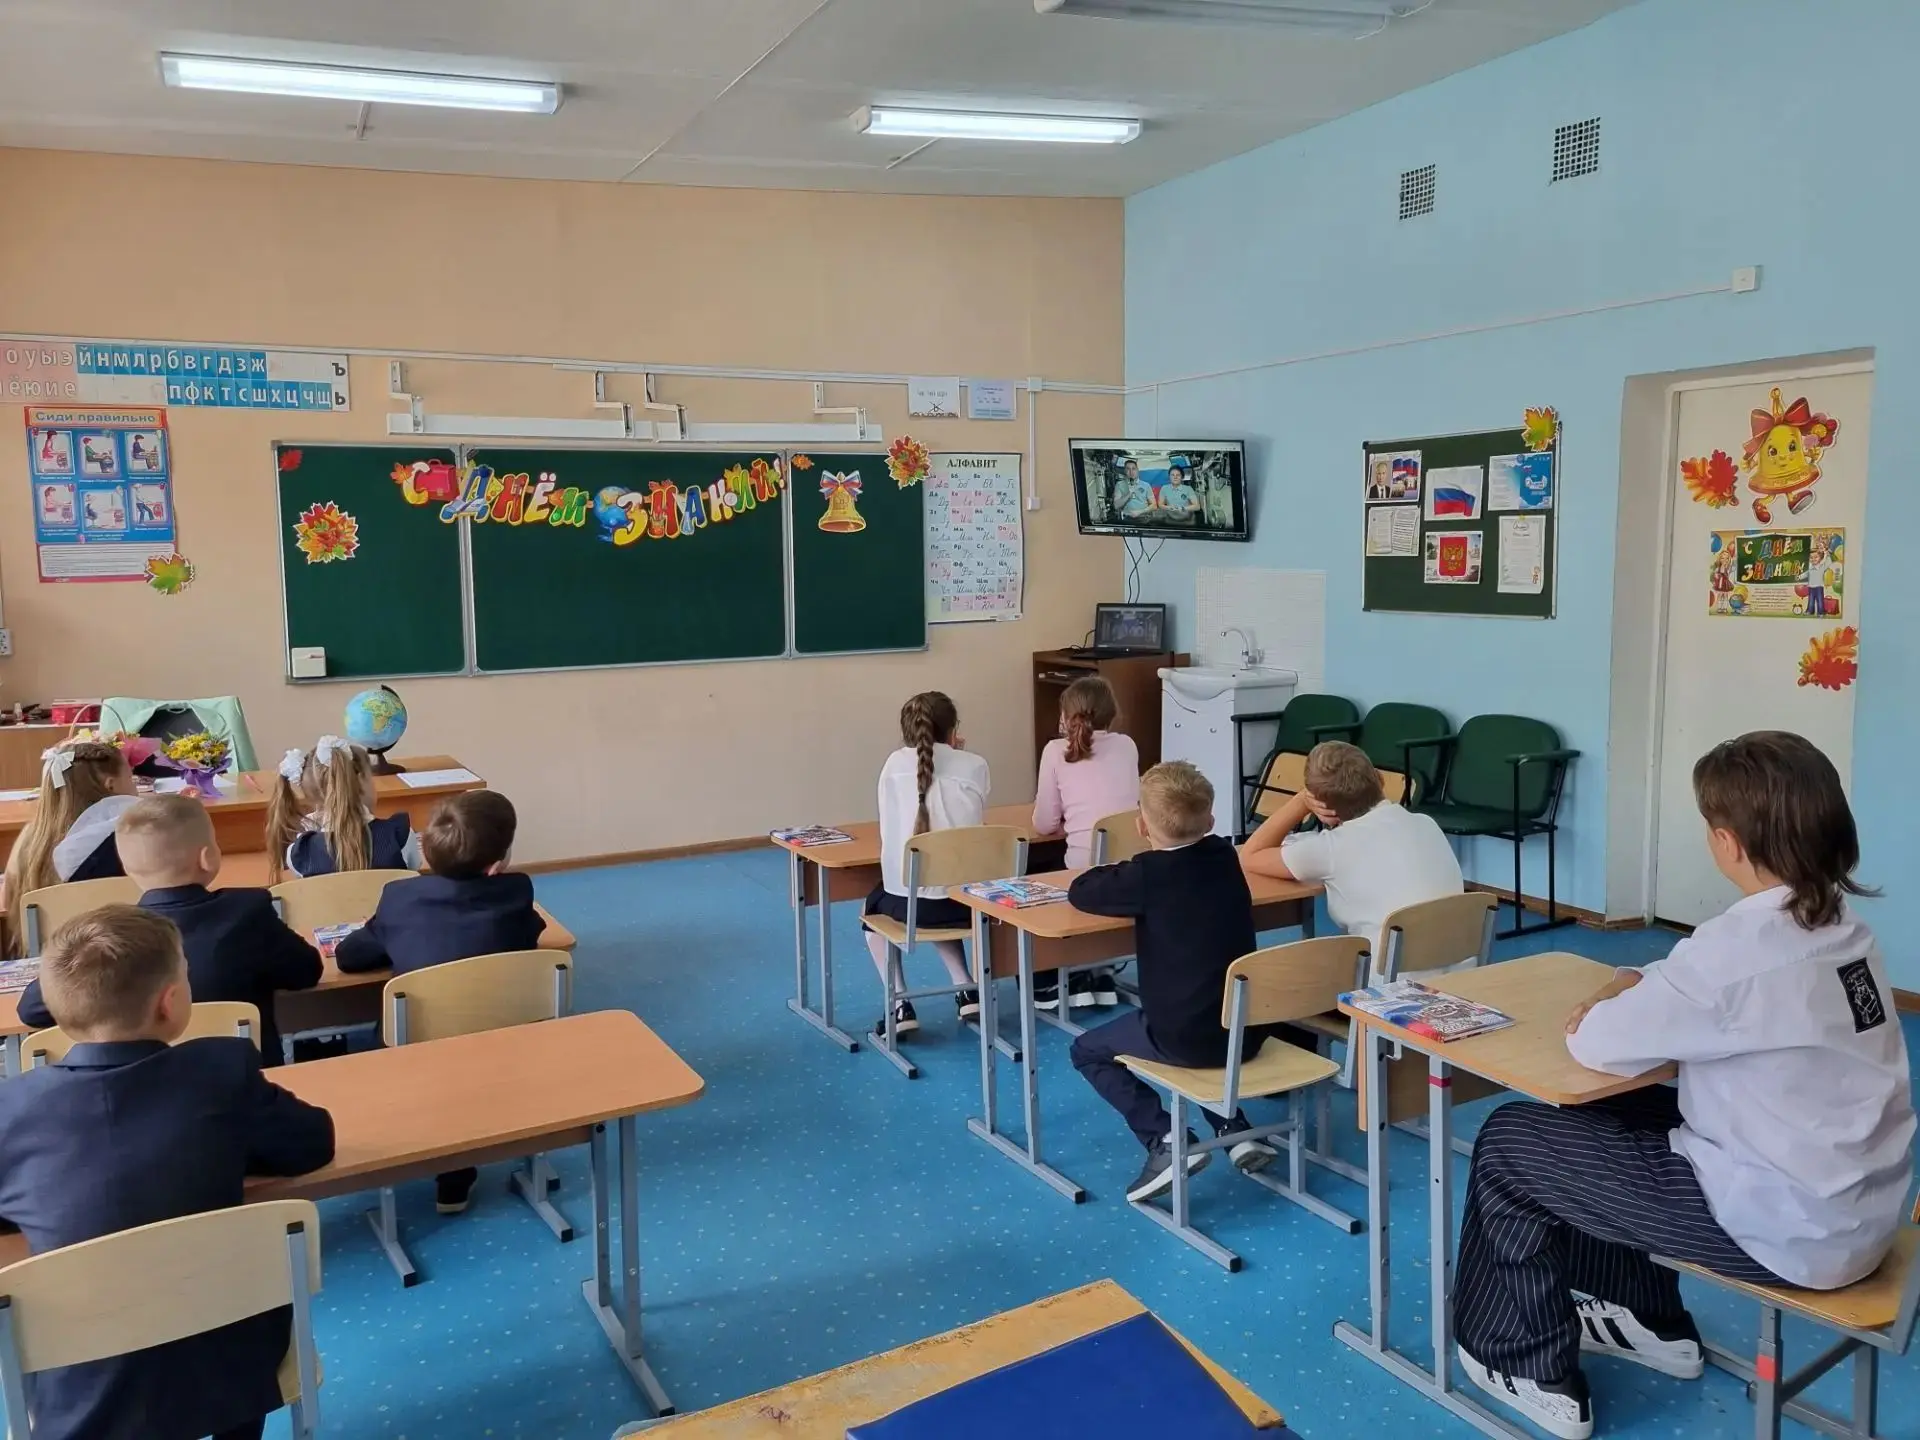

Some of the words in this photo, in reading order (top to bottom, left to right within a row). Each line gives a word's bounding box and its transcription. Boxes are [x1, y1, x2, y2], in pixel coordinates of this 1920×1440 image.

[36, 412, 73, 422] Сиди
[78, 413, 156, 424] правильно
[947, 459, 998, 468] АЛФАВИТ
[402, 461, 430, 505] С
[439, 464, 589, 527] ДНЁМ
[613, 458, 786, 545] ЗНАНИЙ!
[1744, 541, 1754, 554] С
[1759, 537, 1804, 558] ДНЁМ
